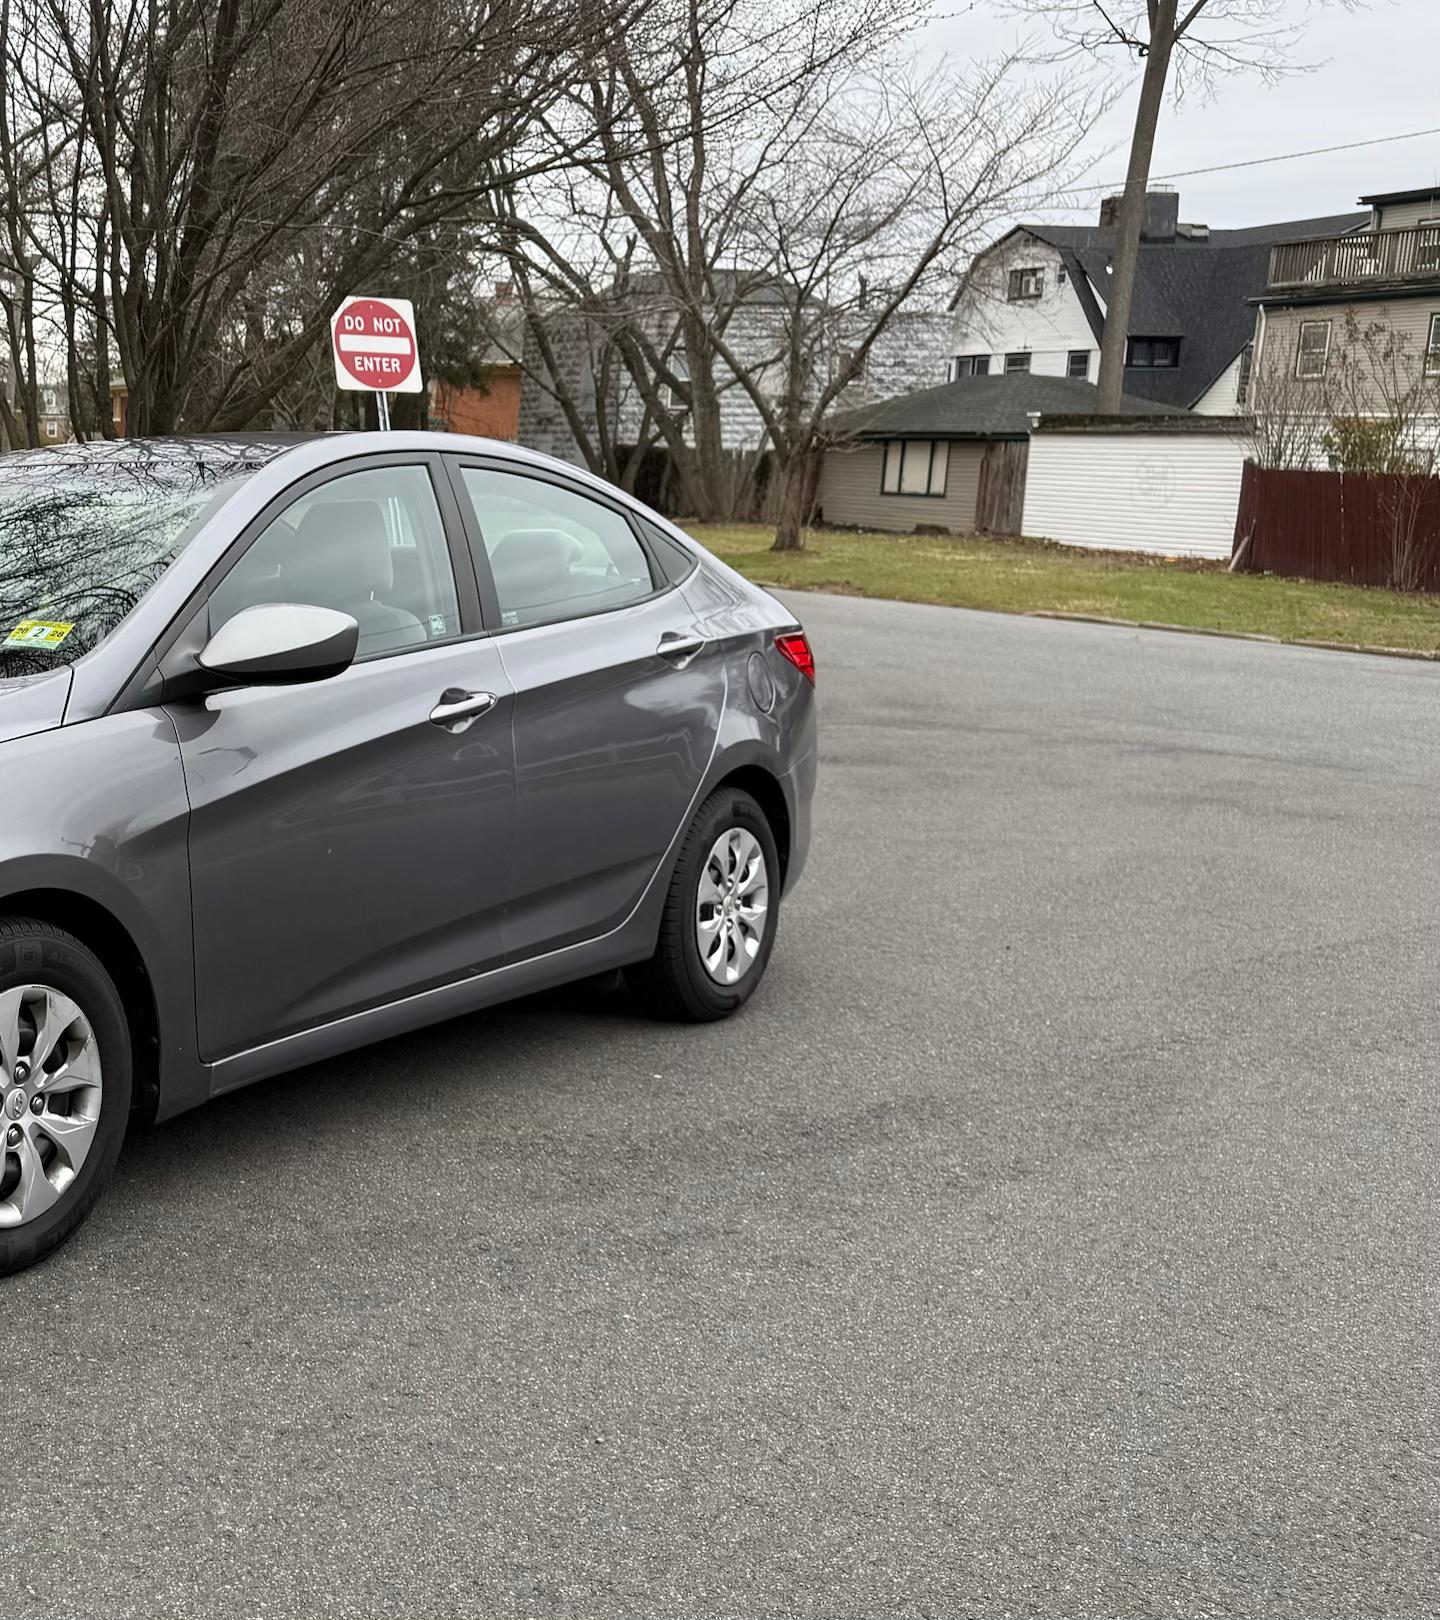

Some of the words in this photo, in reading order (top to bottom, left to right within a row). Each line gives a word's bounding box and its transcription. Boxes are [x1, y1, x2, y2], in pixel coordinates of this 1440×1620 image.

[344, 315, 365, 331] DO
[373, 317, 401, 334] NOT
[354, 356, 401, 373] ENTER
[32, 627, 46, 638] 2
